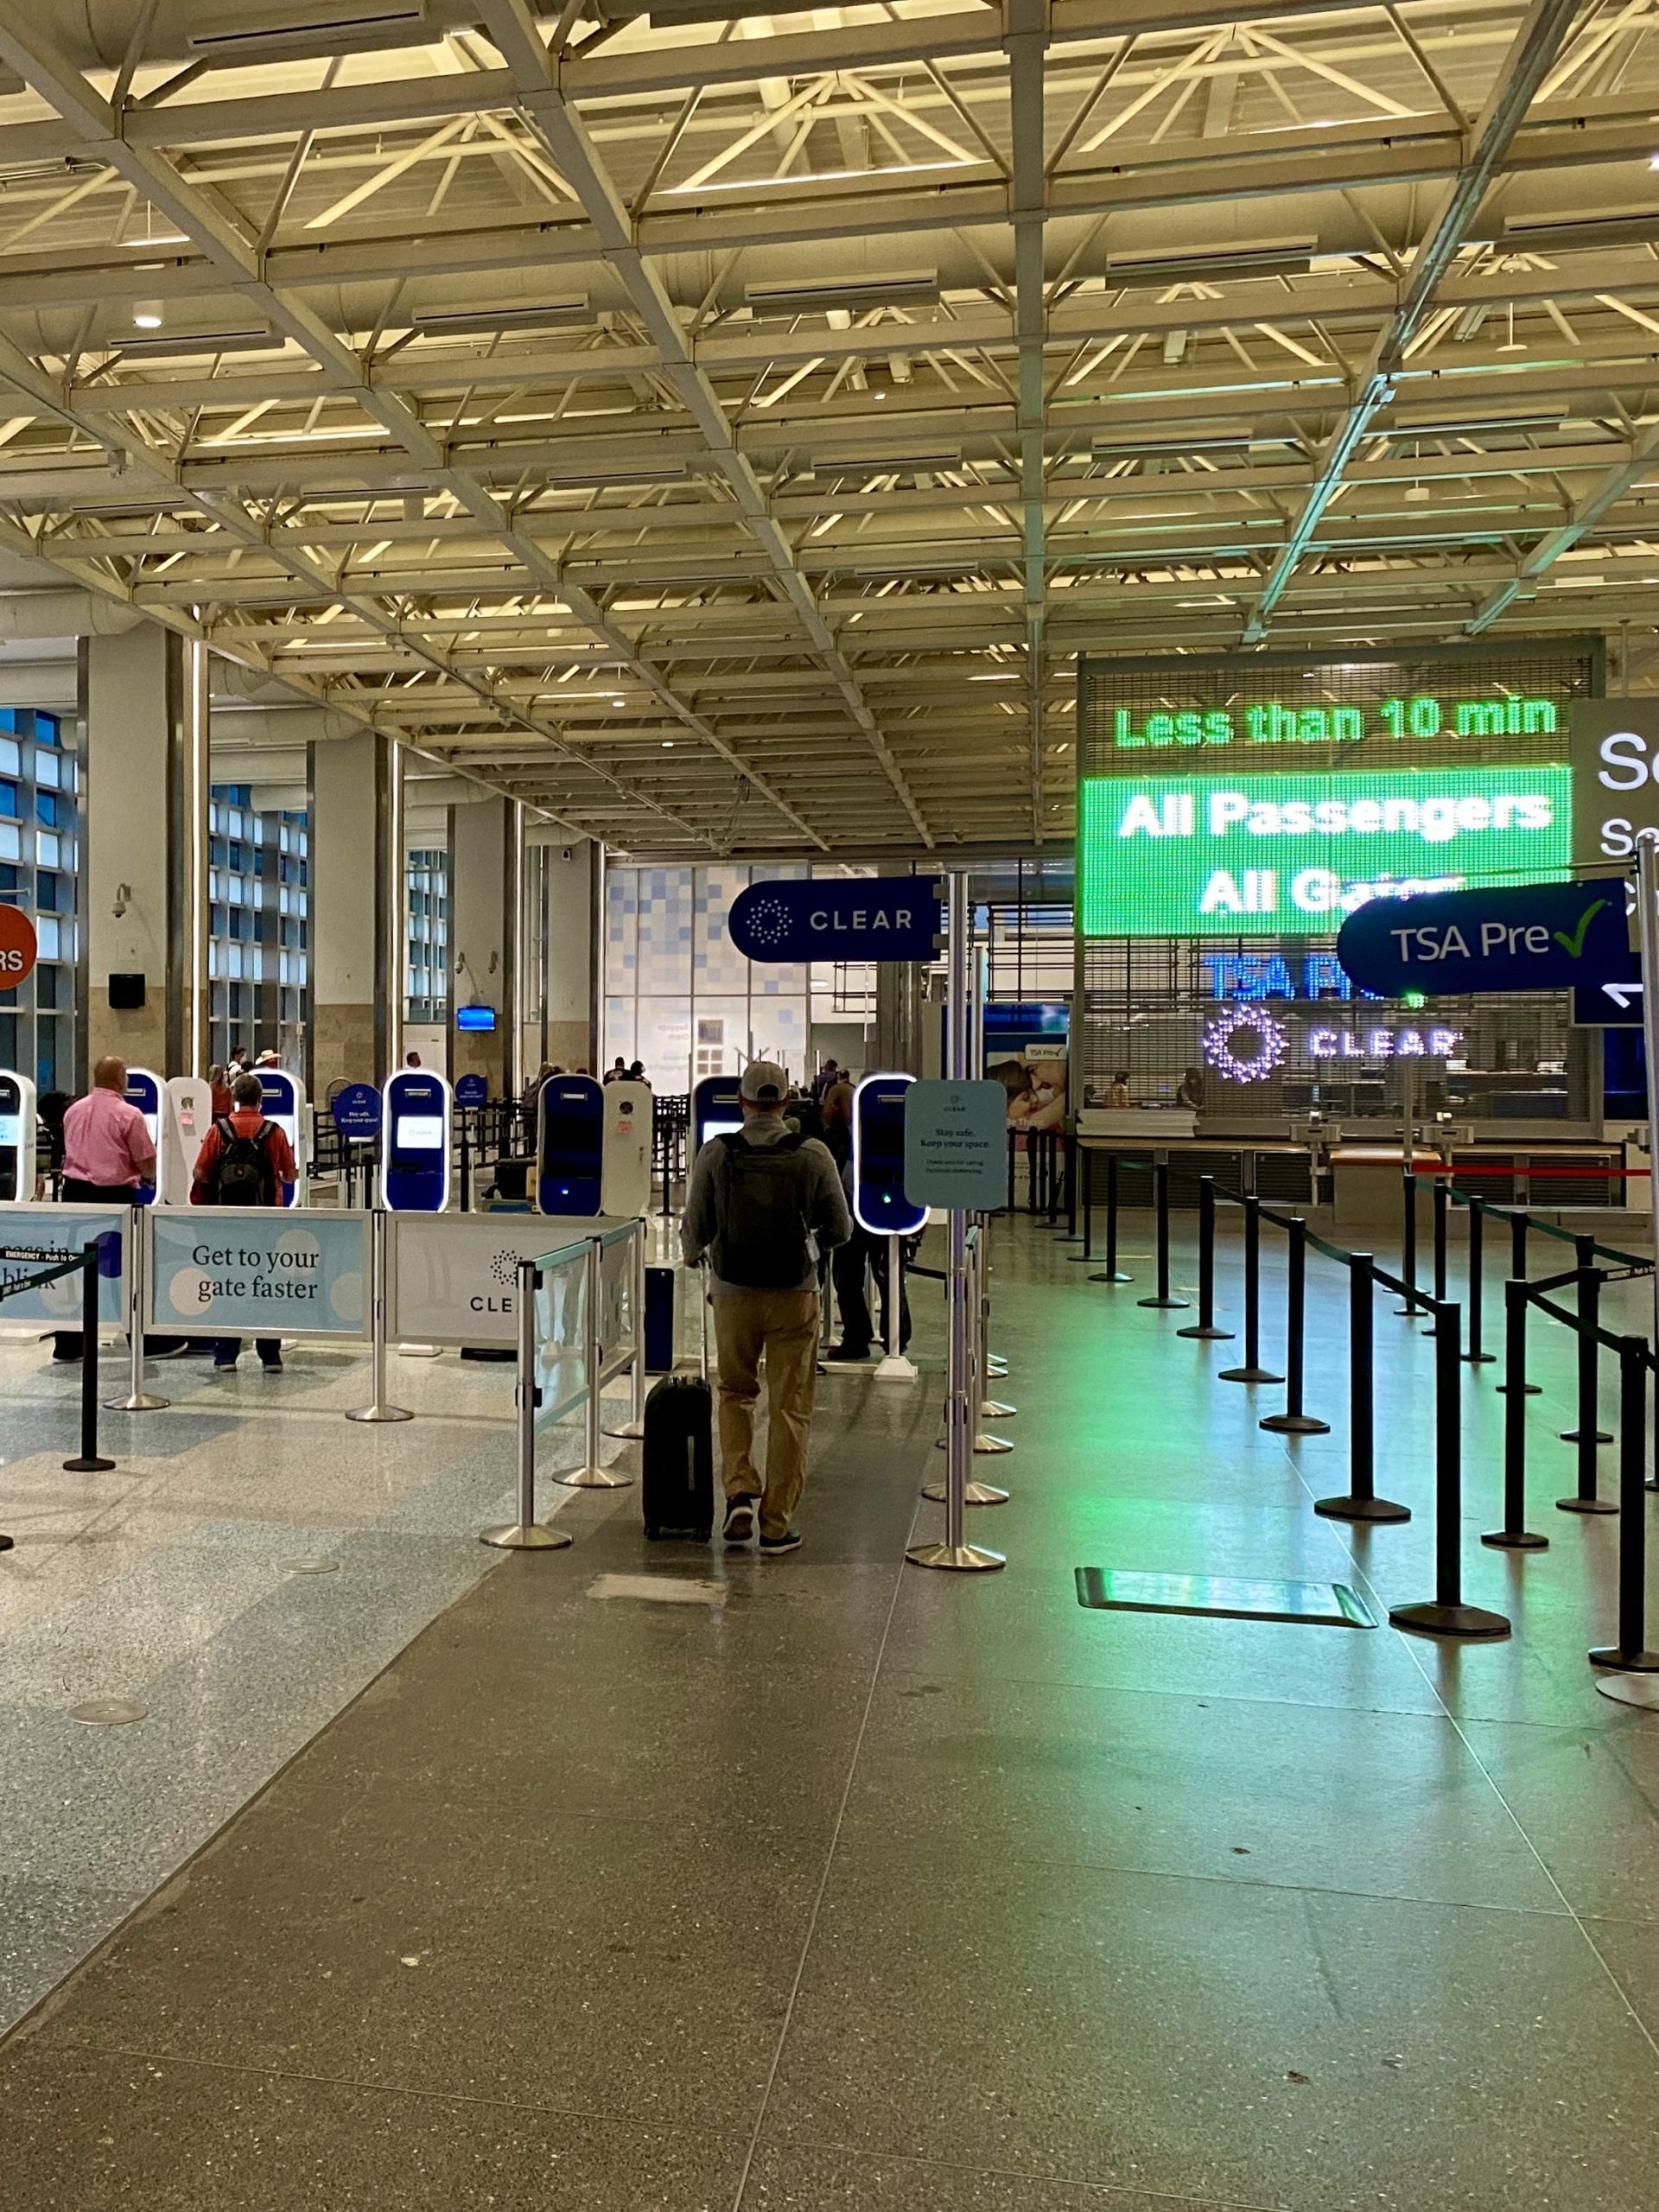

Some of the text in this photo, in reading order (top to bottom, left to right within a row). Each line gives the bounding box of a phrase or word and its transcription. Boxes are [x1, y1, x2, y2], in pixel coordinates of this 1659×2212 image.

[1114, 694, 1558, 748] Less than 10 min
[1599, 733, 1659, 791] S
[1118, 791, 1554, 842] All Passengers
[1199, 868, 1278, 913] All
[810, 910, 912, 931] CLEAR
[1390, 922, 1549, 962] TSA Pre
[1205, 957, 1294, 1001] TSA
[1310, 1030, 1464, 1058] CLEAR
[920, 1140, 942, 1148] Keep
[935, 1128, 954, 1138] Stay
[5, 1250, 40, 1261] EMERGENCY
[193, 1245, 319, 1274] Get to your
[198, 1275, 318, 1302] gate faster
[470, 1296, 517, 1313] CLE
